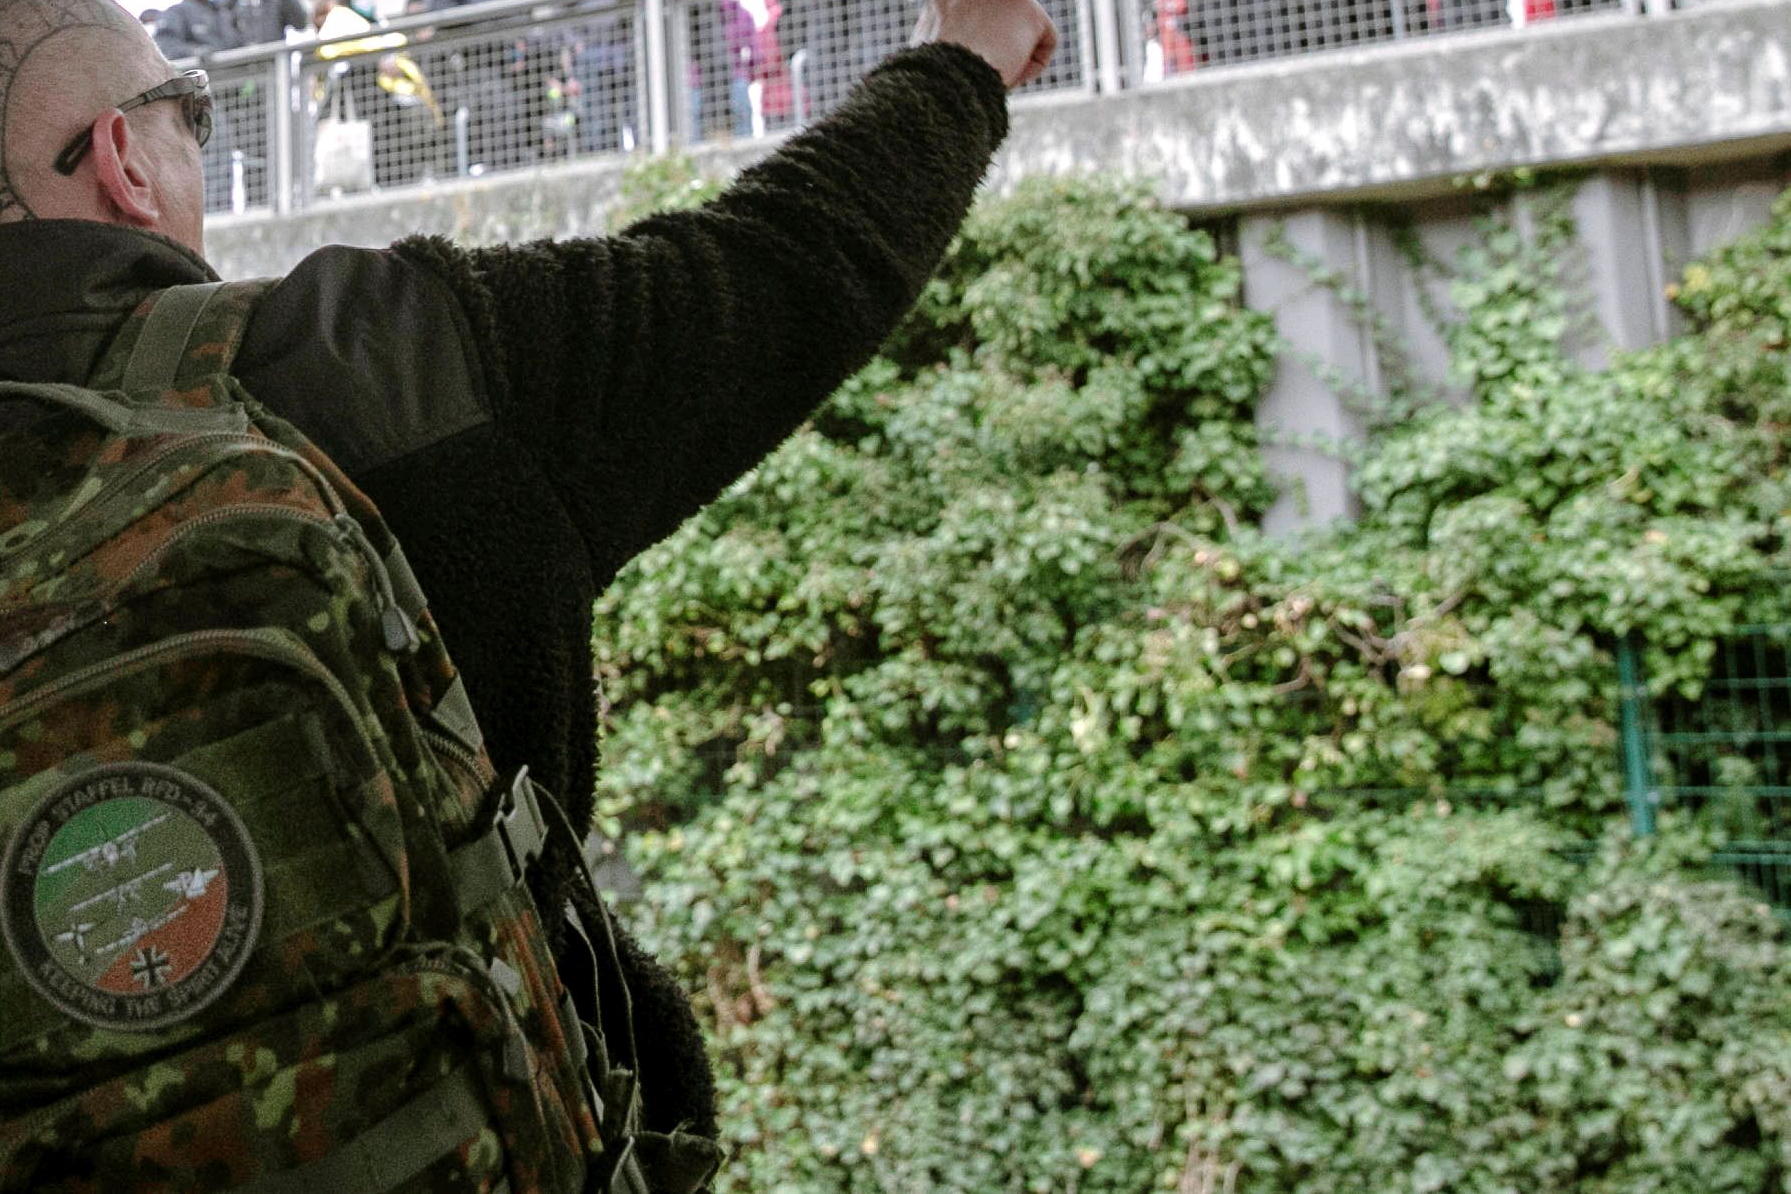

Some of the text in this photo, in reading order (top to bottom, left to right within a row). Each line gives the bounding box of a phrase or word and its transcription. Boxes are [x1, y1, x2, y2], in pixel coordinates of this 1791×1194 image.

[17, 819, 51, 875] PROP
[51, 777, 135, 822] STAFFEL
[39, 906, 248, 1018] KEEPING THE SPIRIT ALIVE
